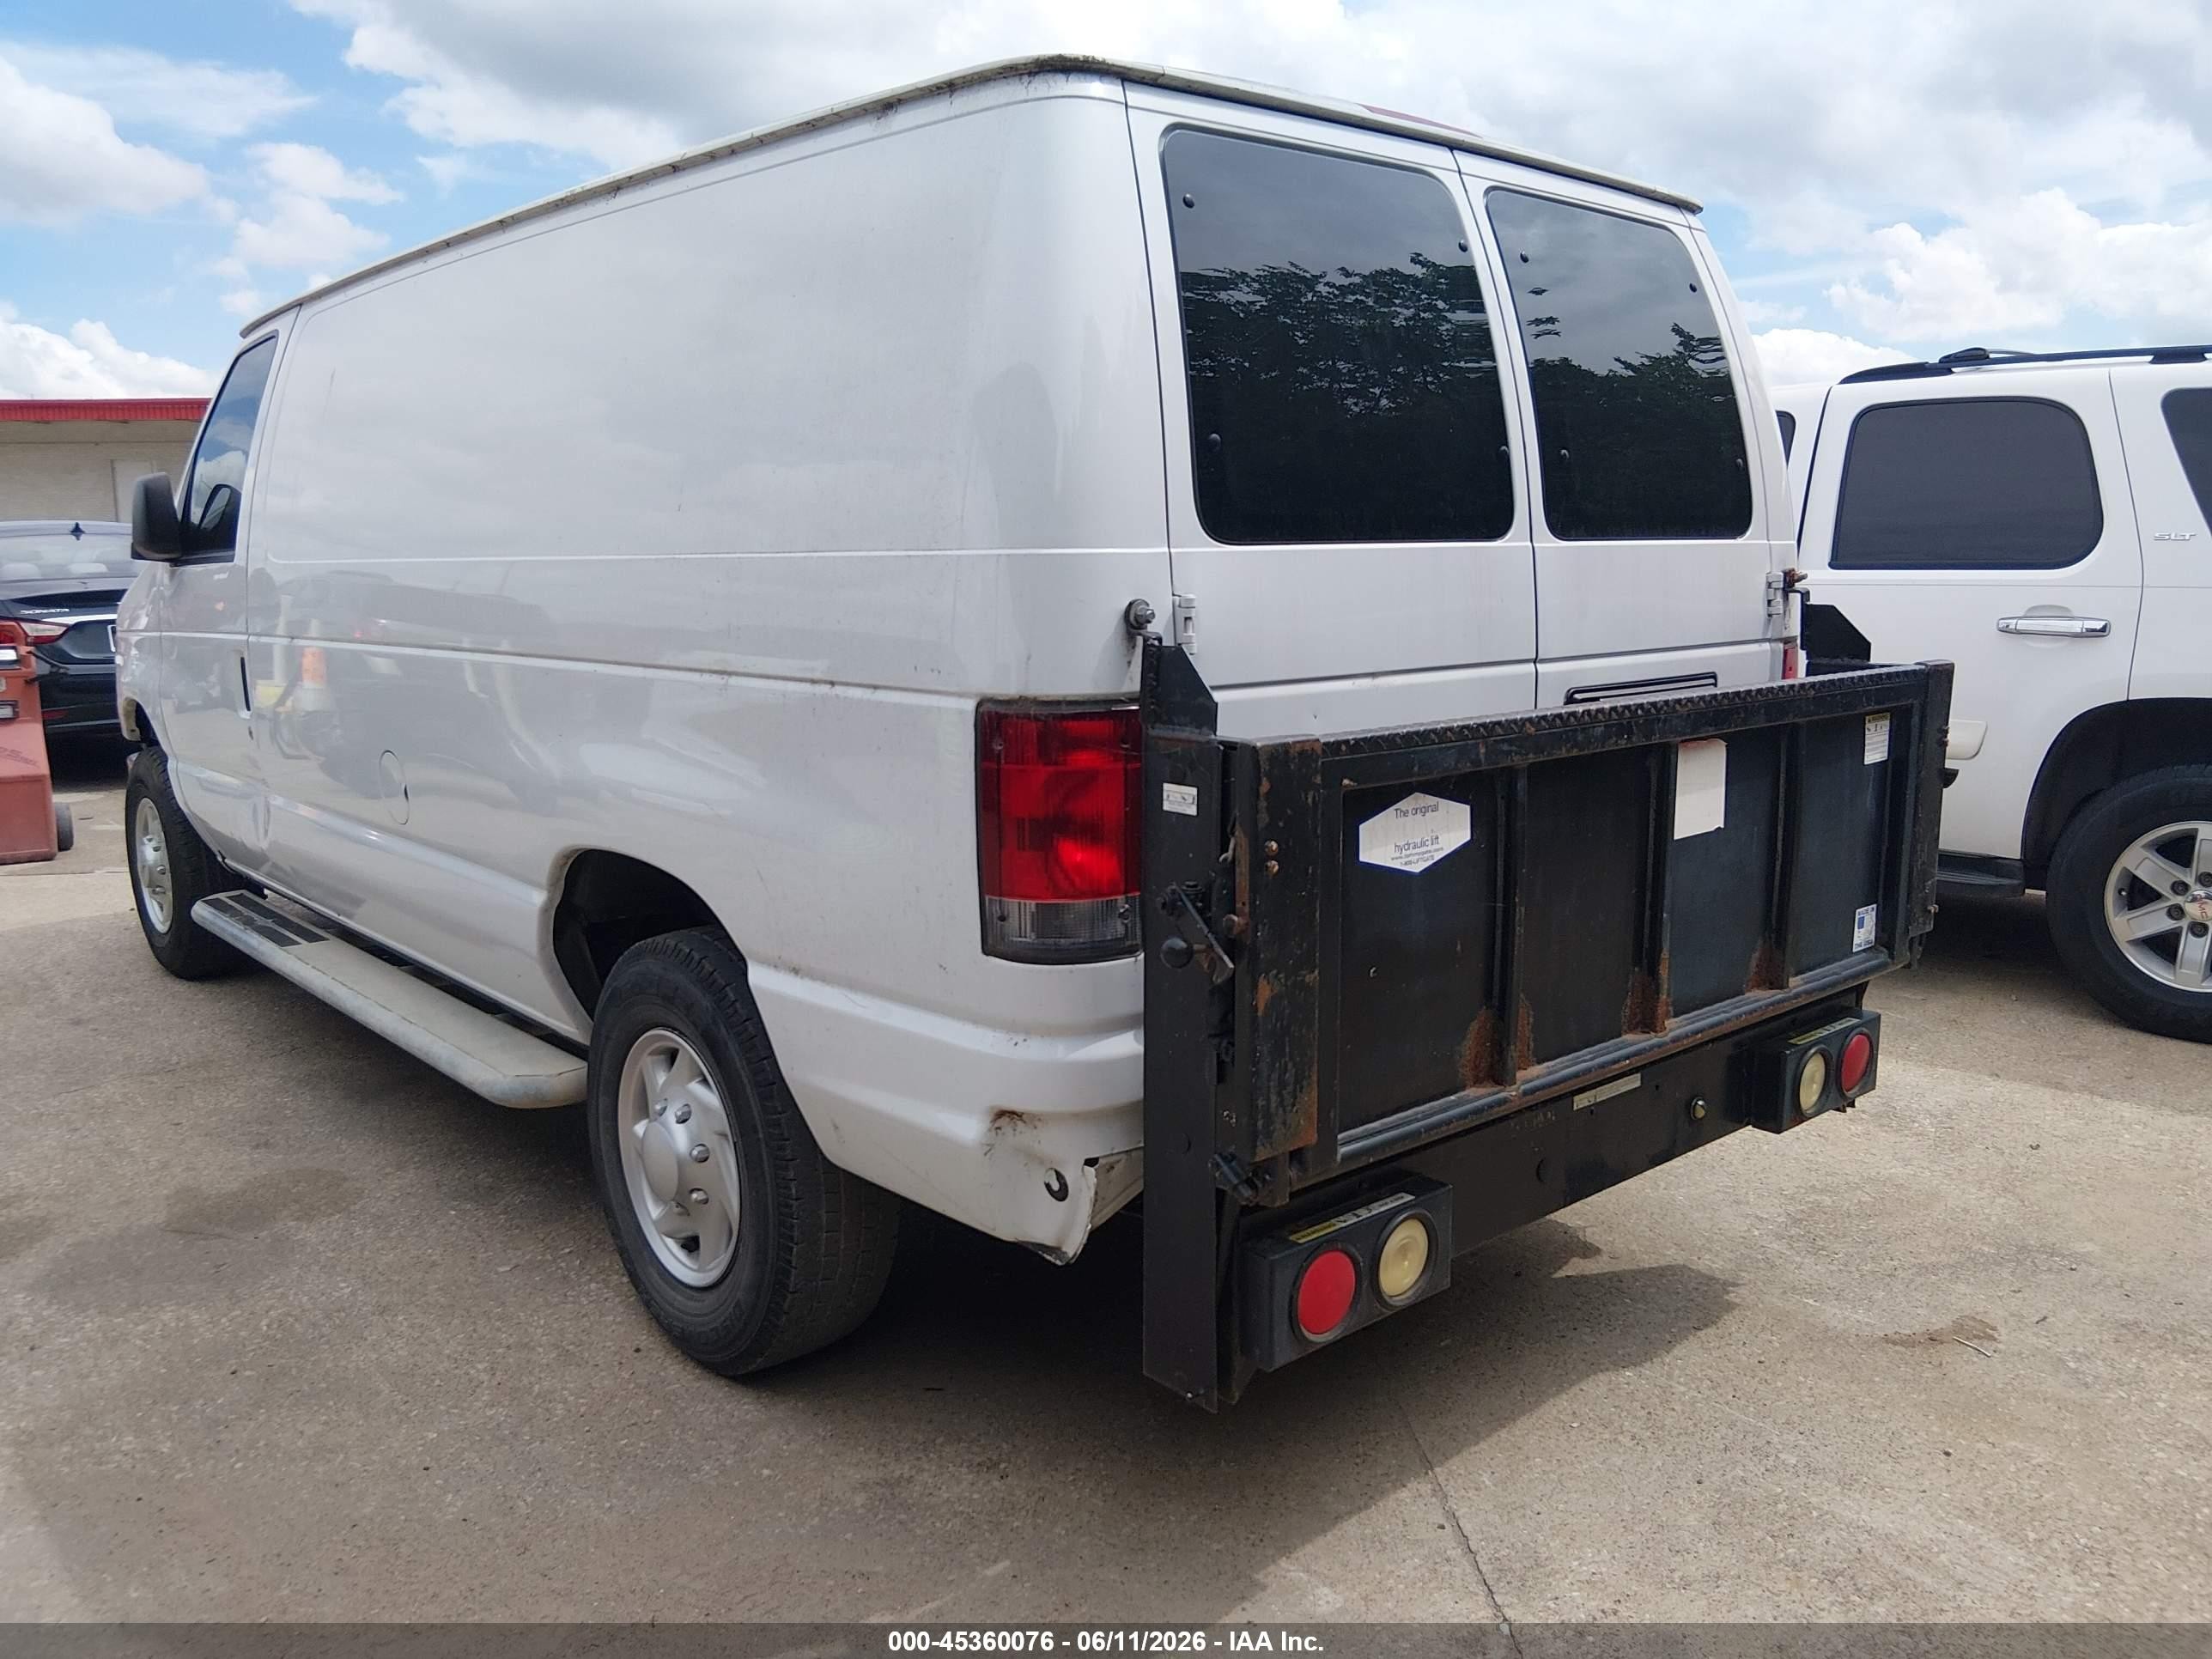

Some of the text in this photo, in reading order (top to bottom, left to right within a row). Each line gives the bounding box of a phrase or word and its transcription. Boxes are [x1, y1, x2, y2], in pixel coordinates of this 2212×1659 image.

[2154, 532, 2197, 541] SLT
[1394, 801, 1440, 819] The original
[1394, 835, 1440, 855] hydraulic lift
